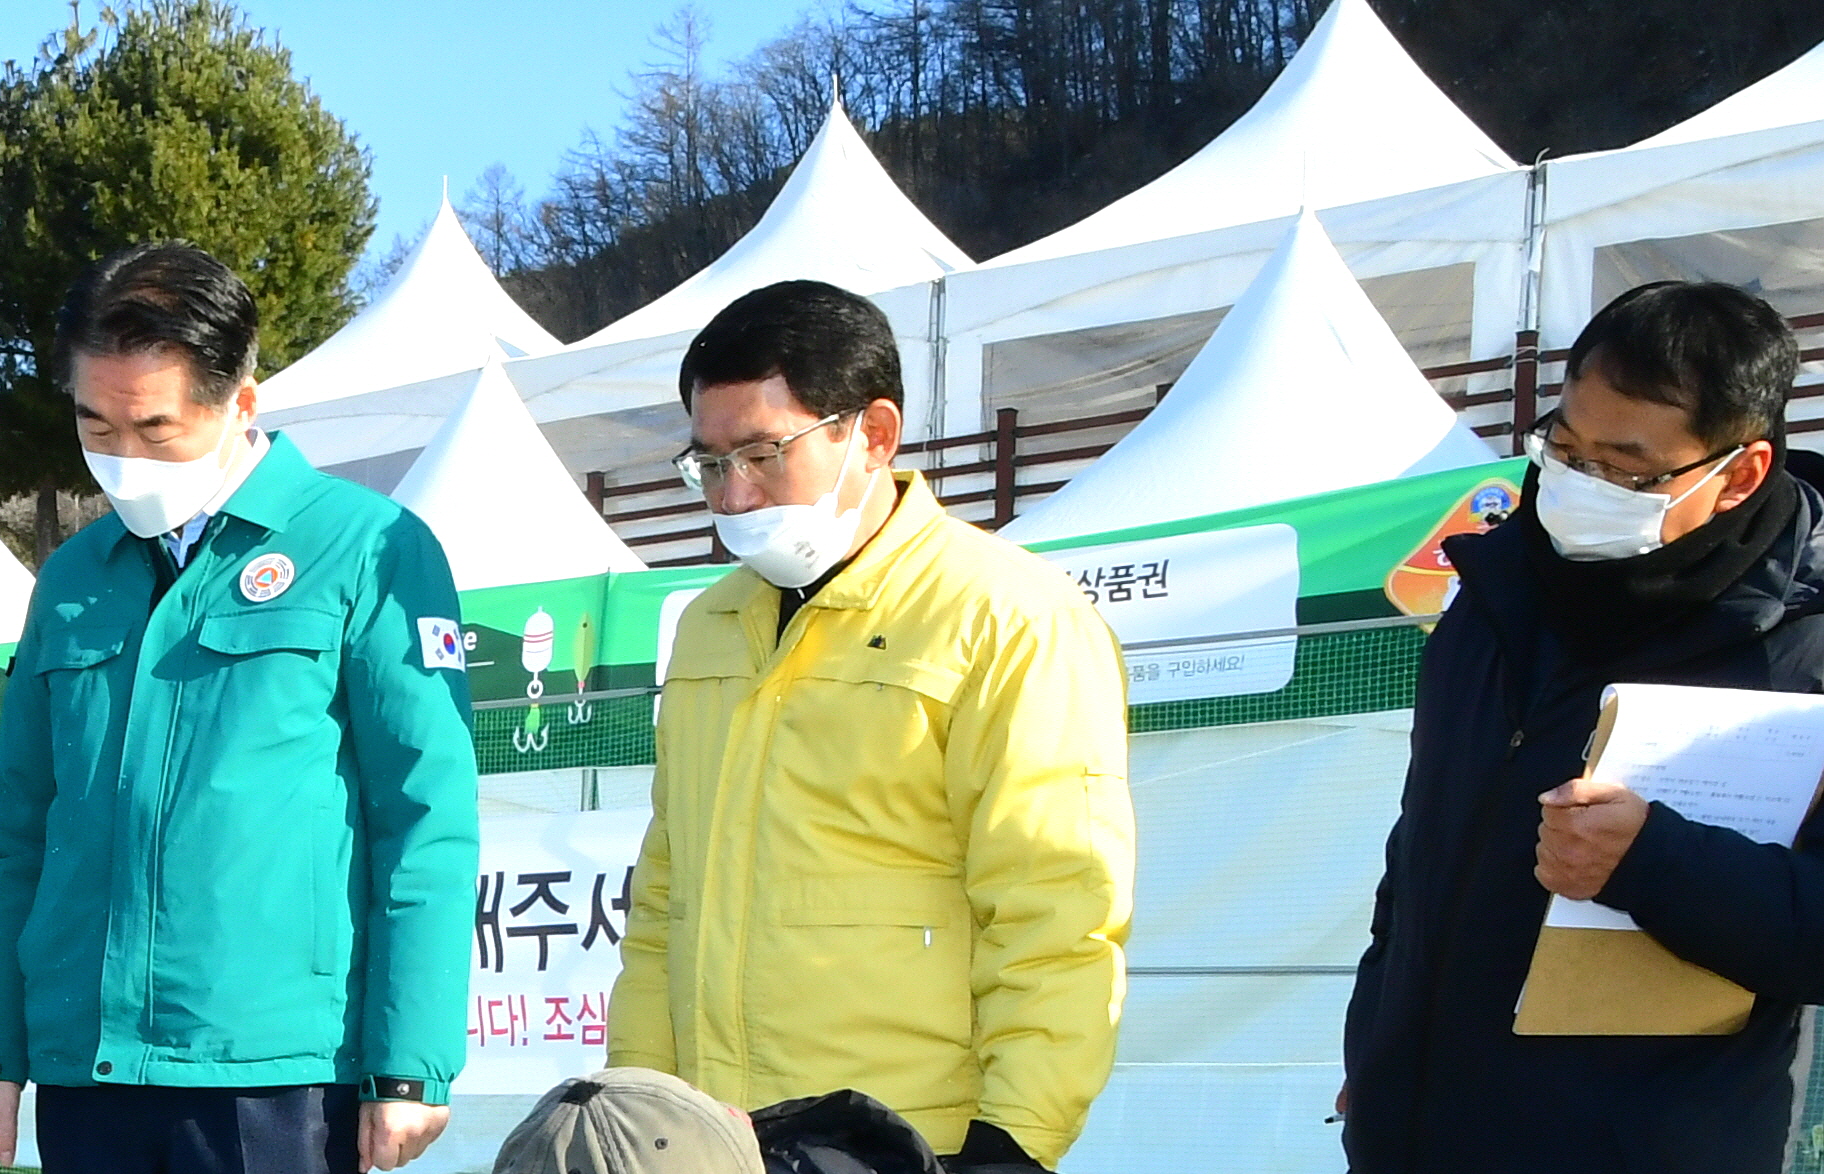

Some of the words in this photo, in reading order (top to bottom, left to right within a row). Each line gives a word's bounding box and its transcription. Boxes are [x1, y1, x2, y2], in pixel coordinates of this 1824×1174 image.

[1066, 559, 1170, 605] 상품권
[1126, 662, 1161, 684] 품을
[1167, 655, 1245, 678] 구입하세요!
[543, 992, 607, 1046] 조심
